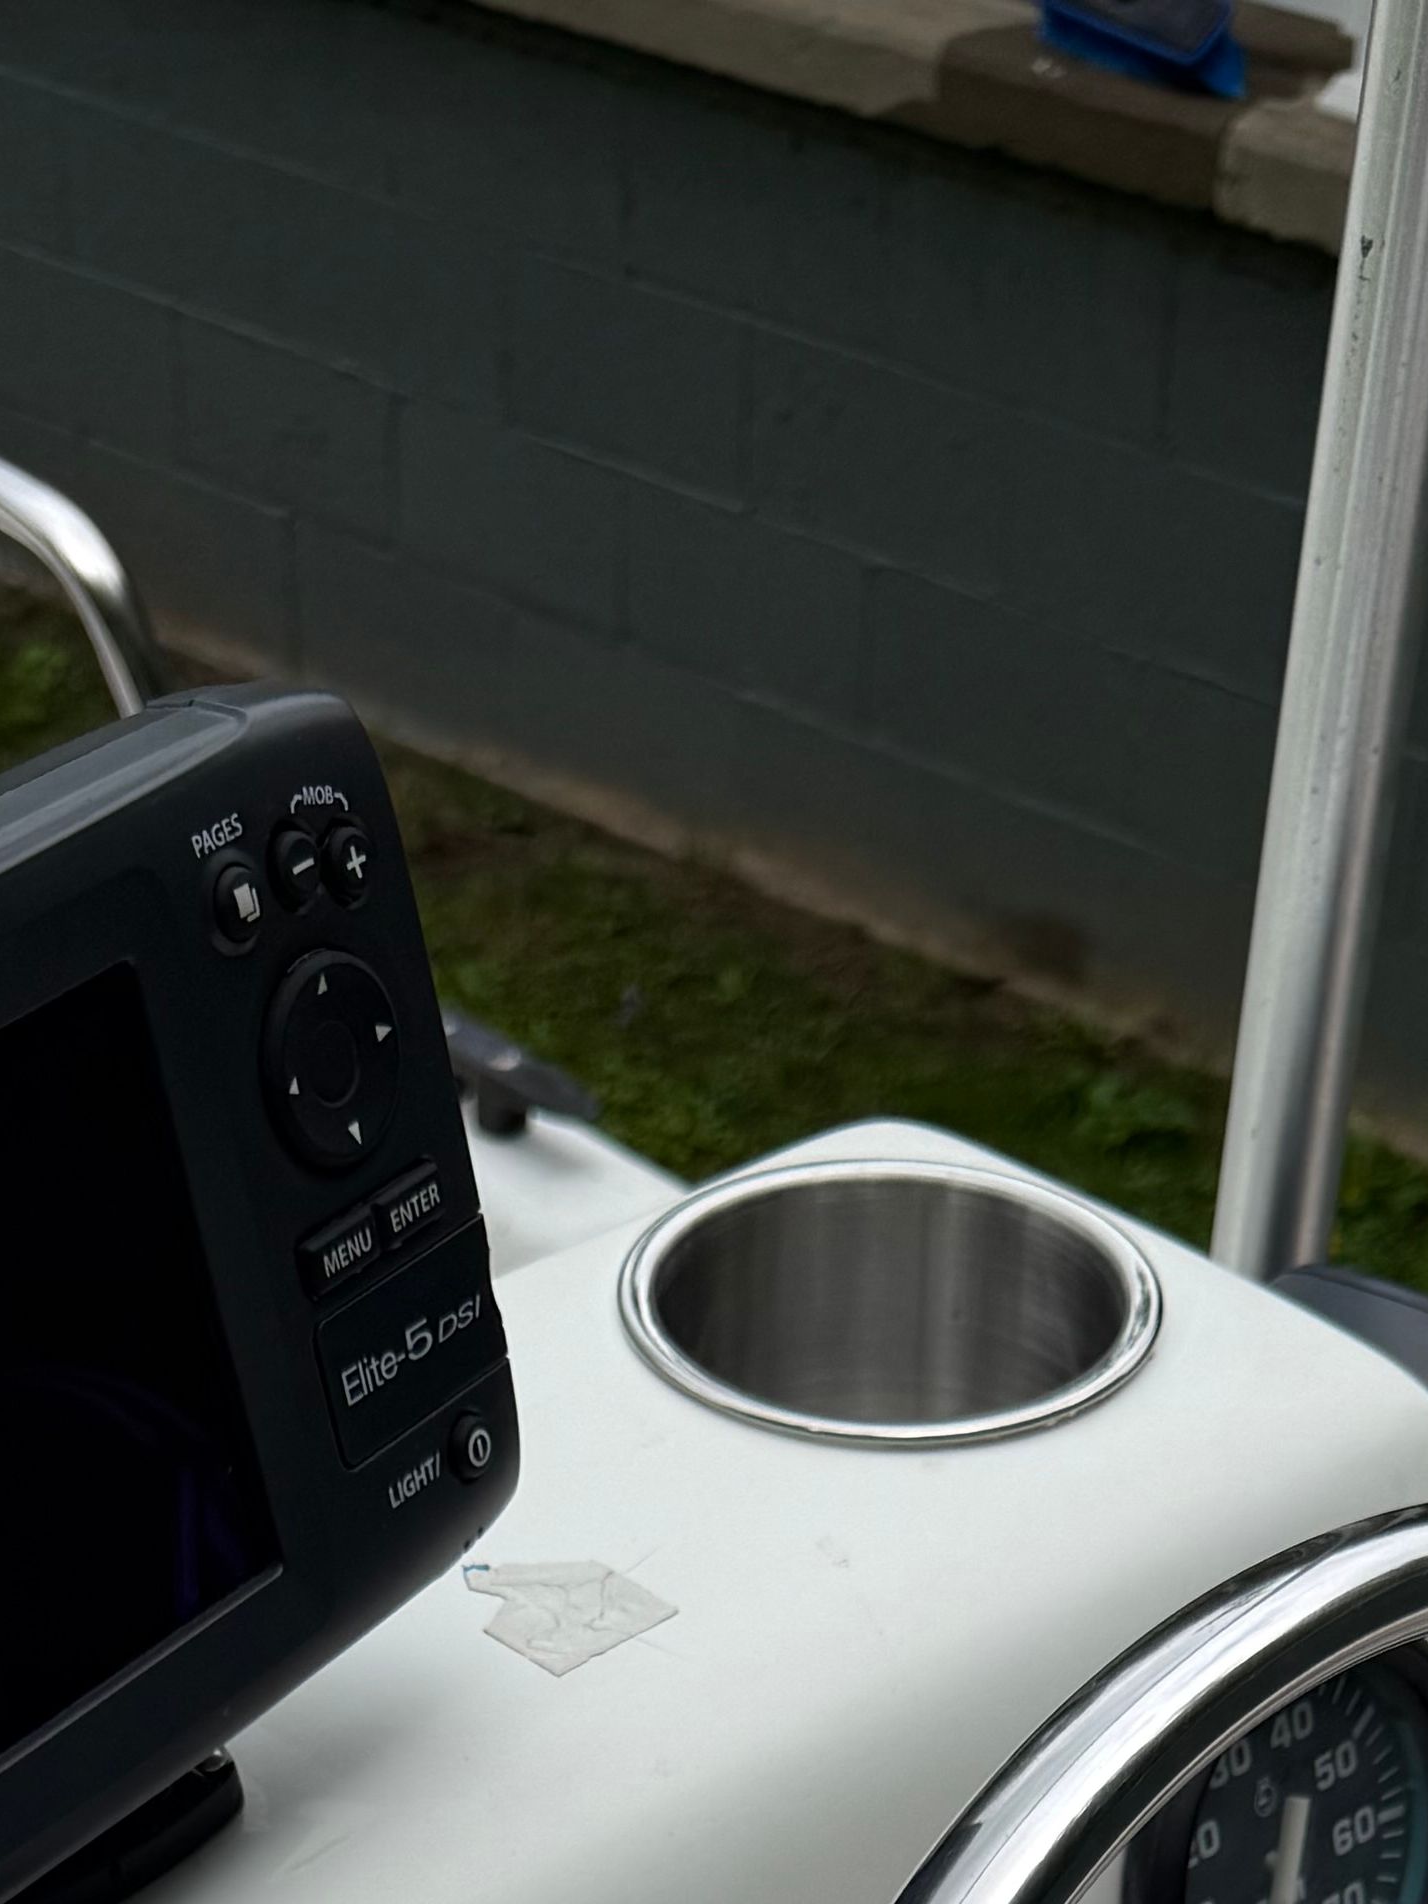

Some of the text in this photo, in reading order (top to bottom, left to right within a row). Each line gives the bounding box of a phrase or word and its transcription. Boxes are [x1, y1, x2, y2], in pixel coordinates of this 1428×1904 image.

[302, 785, 334, 806] MOB
[191, 812, 243, 859] PAGES
[390, 1183, 441, 1233] ENTER
[323, 1226, 372, 1278] MENU
[341, 1294, 481, 1407] Elite-5 DSI
[1269, 1701, 1314, 1750] 40
[1314, 1739, 1357, 1791] 50
[1332, 1805, 1375, 1856] 60
